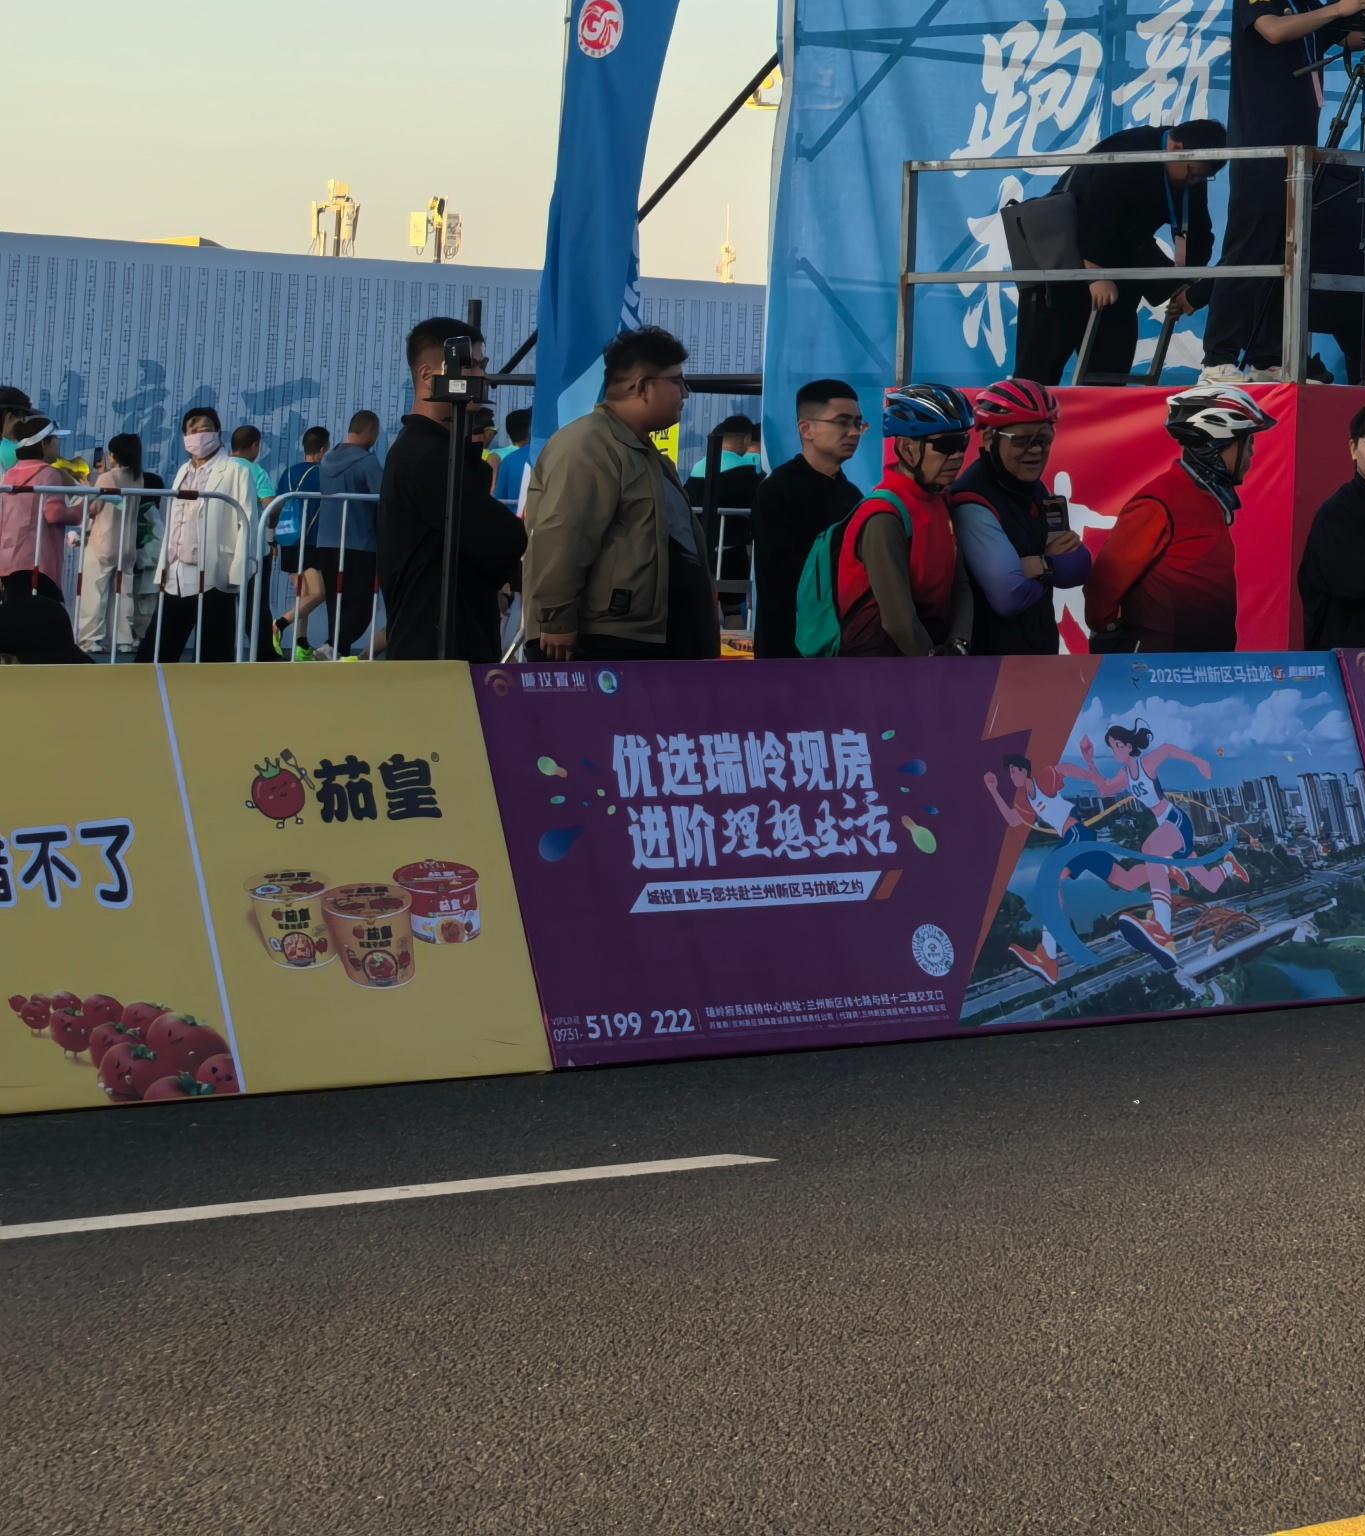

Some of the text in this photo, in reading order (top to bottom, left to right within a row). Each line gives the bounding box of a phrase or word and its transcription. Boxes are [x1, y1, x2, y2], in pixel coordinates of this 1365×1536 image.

[1150, 665, 1272, 683] 2026兰州新区马拉松
[315, 754, 443, 823] 茄皇
[612, 728, 874, 798] 优选瑞岭现房
[627, 791, 898, 870] 进阶理想生活
[586, 1012, 641, 1039] 5199
[651, 1009, 695, 1034] 222
